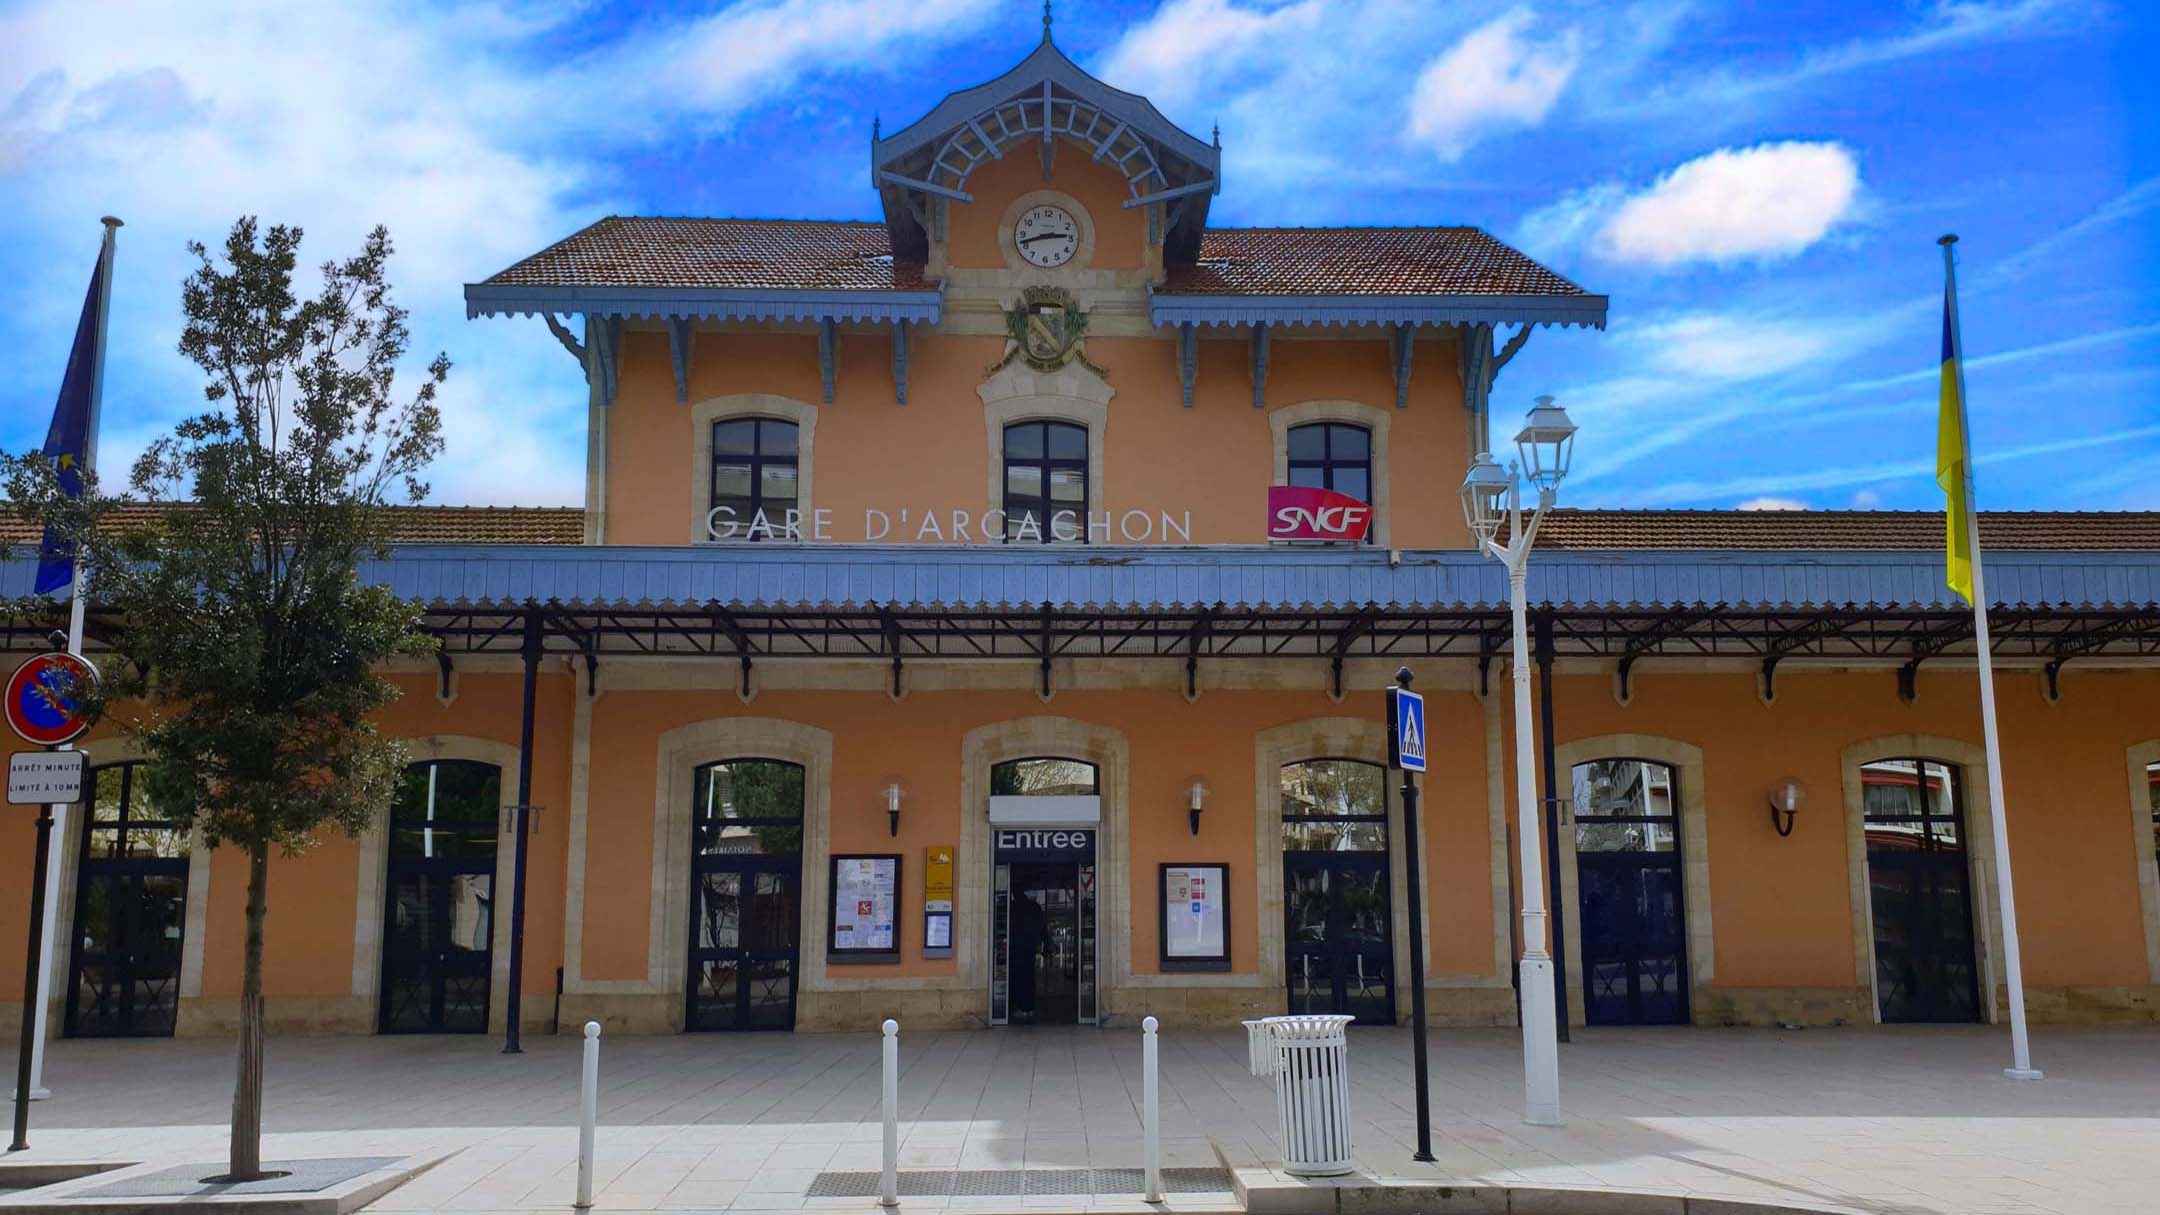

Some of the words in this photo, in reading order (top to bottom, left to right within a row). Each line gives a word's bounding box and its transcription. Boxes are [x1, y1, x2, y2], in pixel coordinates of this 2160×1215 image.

[1024, 219, 1033, 227] 10
[1065, 222, 1071, 230] 2
[1054, 253, 1060, 261] 5
[706, 505, 833, 540] GARE
[865, 508, 1191, 542] D'ARCACHON
[1272, 506, 1368, 533] SNCF
[45, 763, 81, 772] MINUTE
